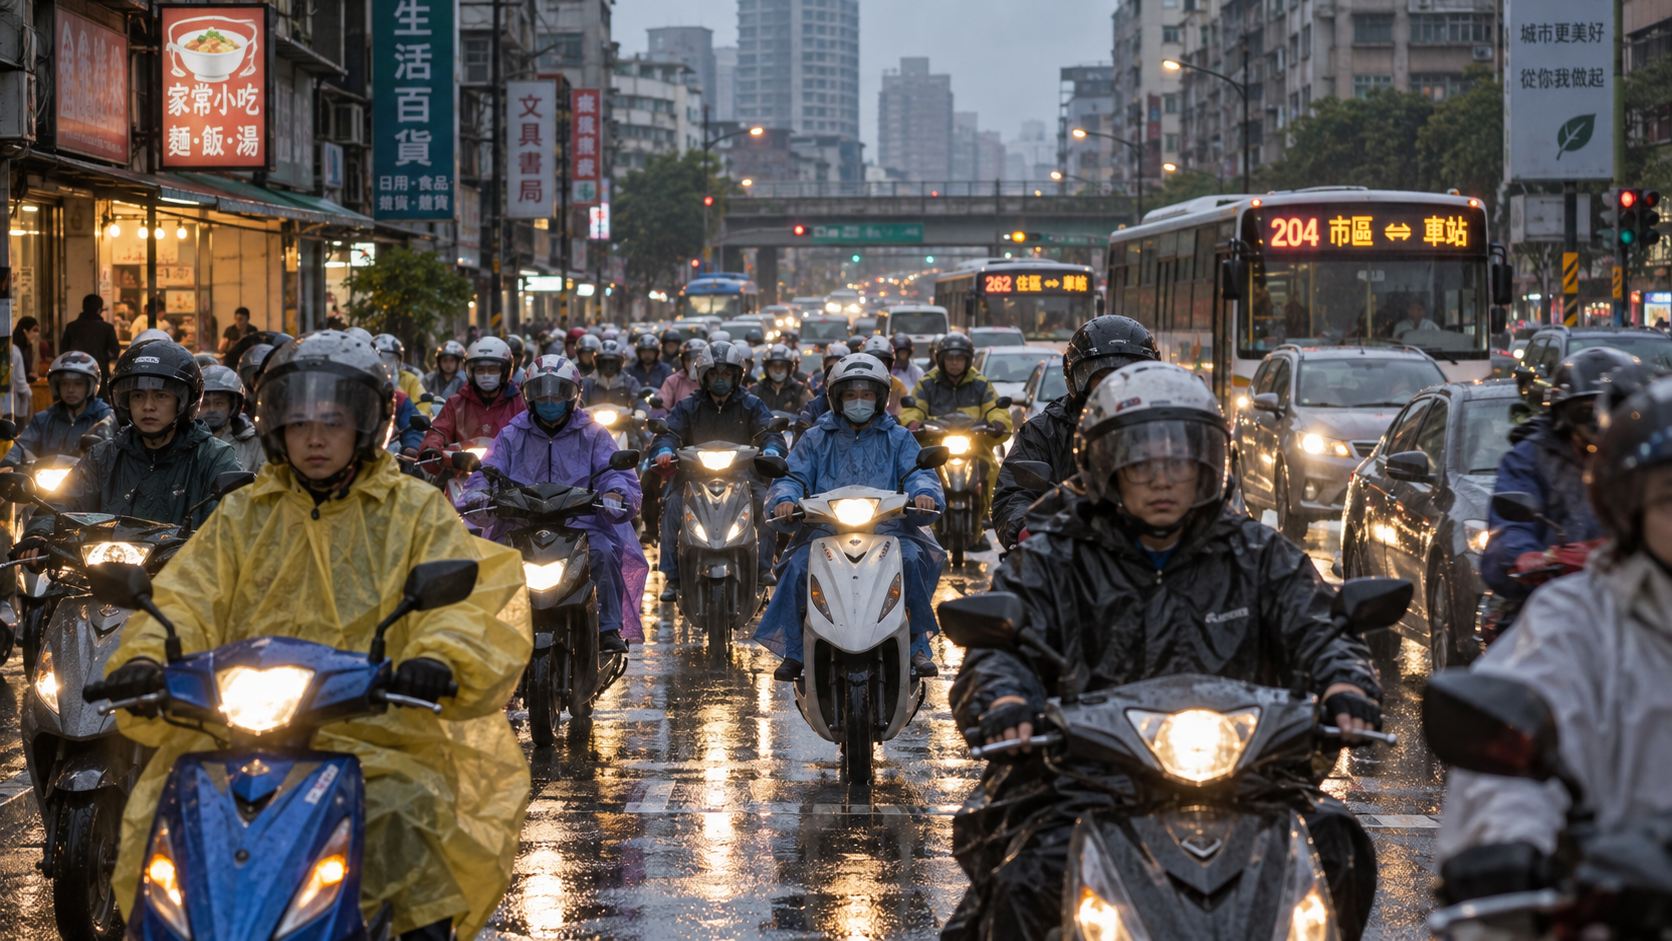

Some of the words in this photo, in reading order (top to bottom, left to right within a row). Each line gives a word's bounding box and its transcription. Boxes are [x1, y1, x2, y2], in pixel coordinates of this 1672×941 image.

[1520, 22, 1605, 44] 城市更美好
[394, 0, 432, 167] 生活百貨
[1520, 67, 1605, 89] 從你我做起
[167, 83, 260, 117] 家常小吃
[518, 94, 543, 204] 文具書局
[1270, 217, 1320, 247] 204
[1329, 215, 1374, 247] 市區
[1423, 215, 1468, 247] 車站
[985, 275, 1012, 292] 262
